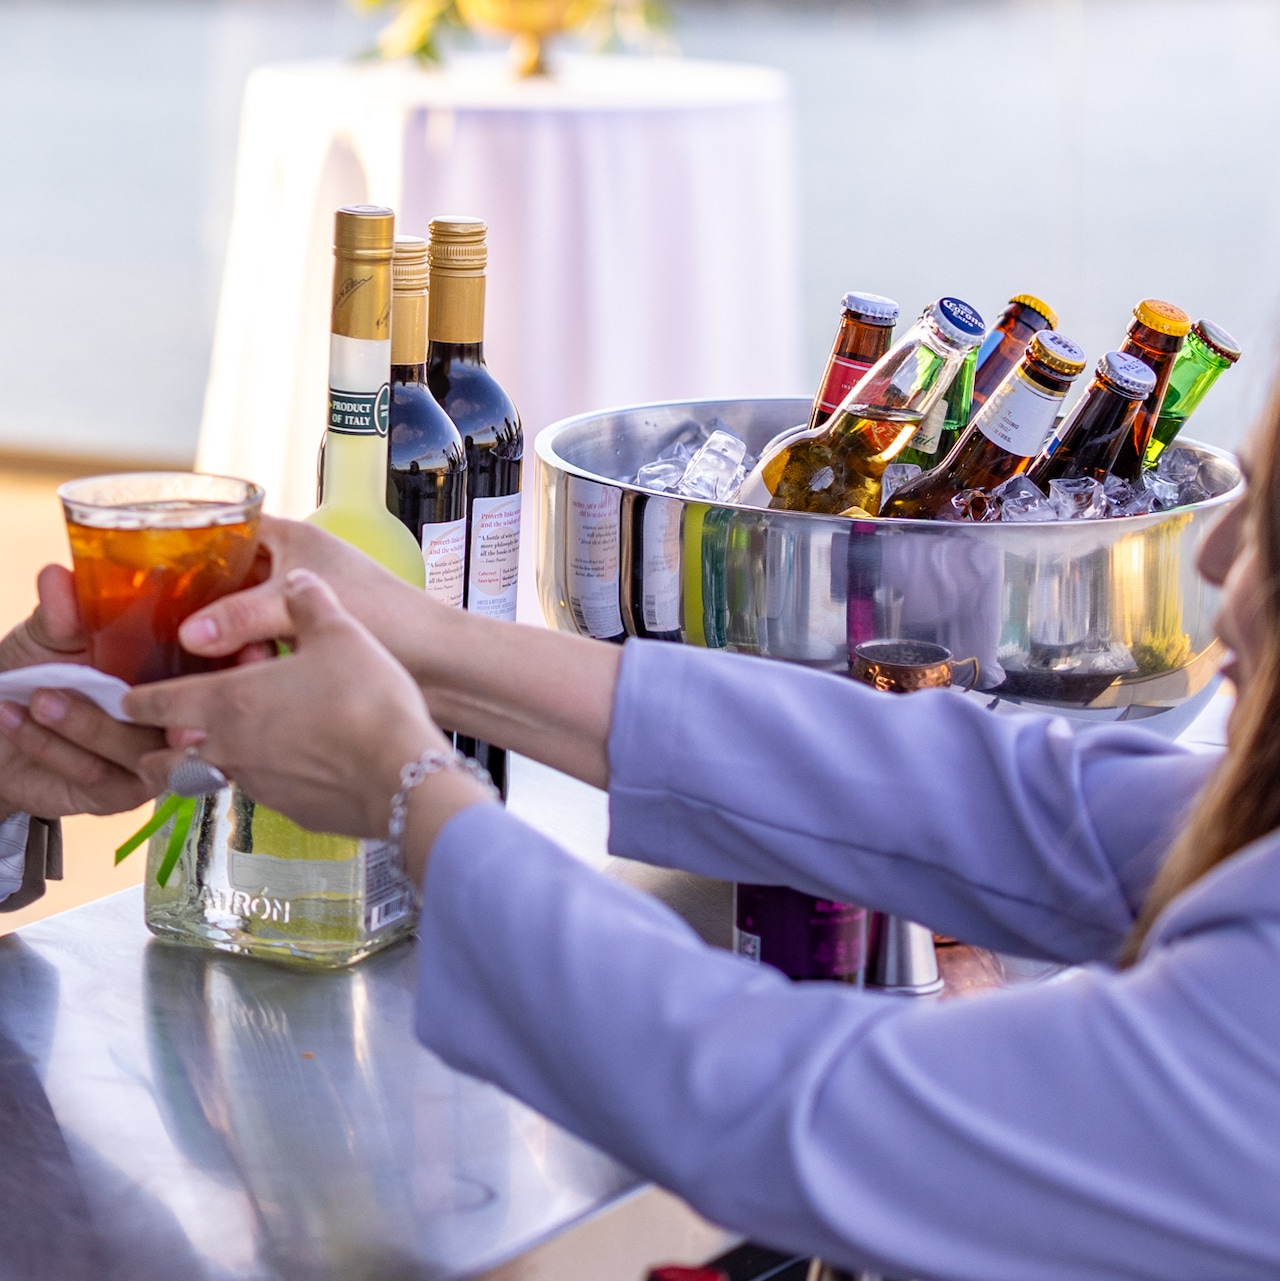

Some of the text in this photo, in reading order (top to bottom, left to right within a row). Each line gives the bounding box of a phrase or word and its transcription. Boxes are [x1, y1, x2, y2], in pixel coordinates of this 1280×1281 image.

[943, 300, 984, 330] Corona
[953, 310, 973, 327] Extra
[1049, 335, 1077, 354] Lite
[333, 401, 371, 413] PRODUCT
[332, 414, 371, 425] OF ITALY
[482, 512, 503, 520] Proverb
[430, 538, 450, 547] Proverb
